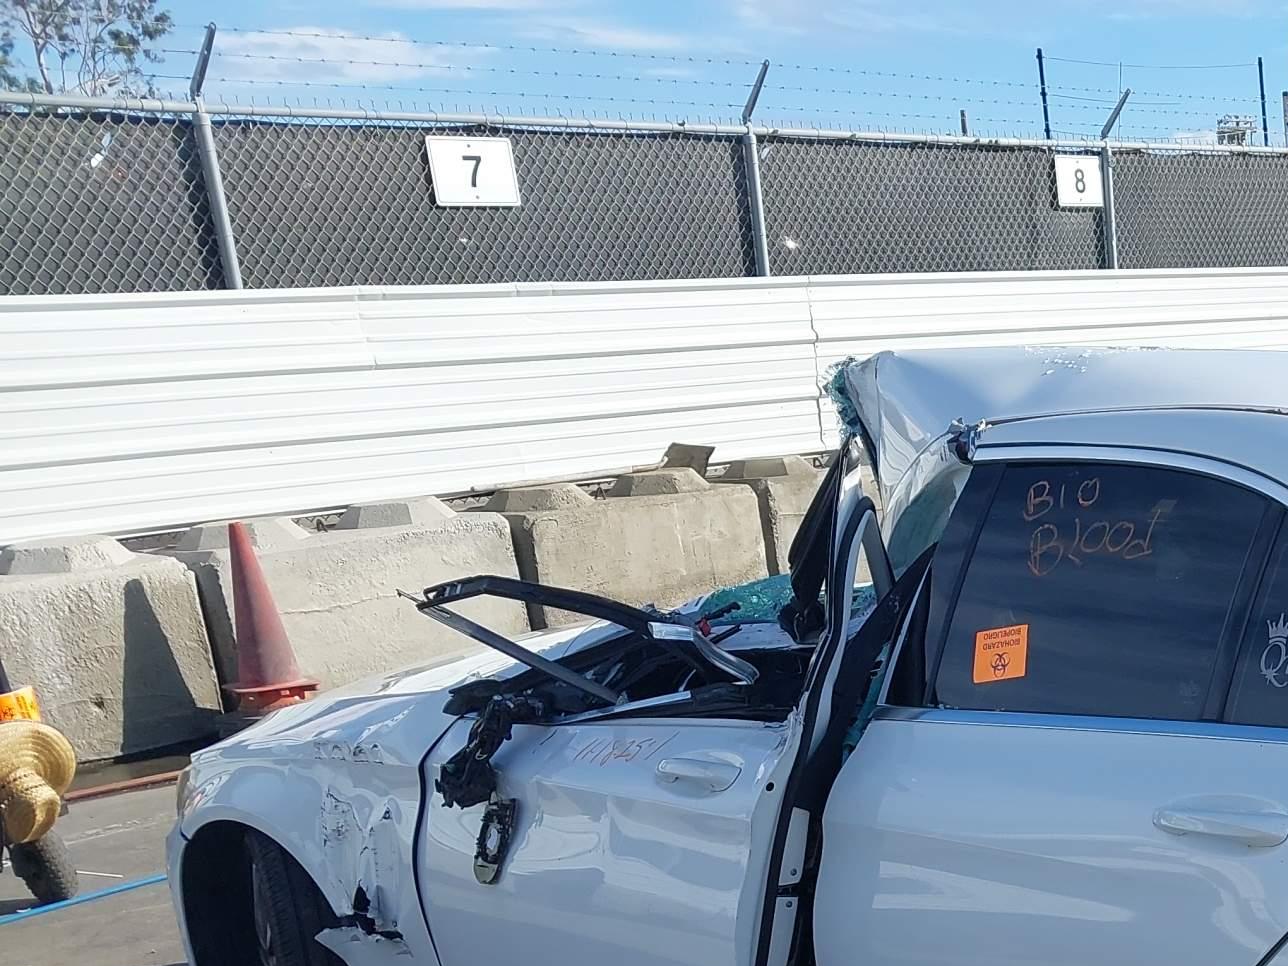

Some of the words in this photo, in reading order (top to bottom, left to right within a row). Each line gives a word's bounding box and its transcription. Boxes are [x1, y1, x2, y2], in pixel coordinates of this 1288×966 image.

[461, 154, 482, 188] 7
[1073, 167, 1086, 194] 8
[982, 638, 1021, 651] BIOHAZARD
